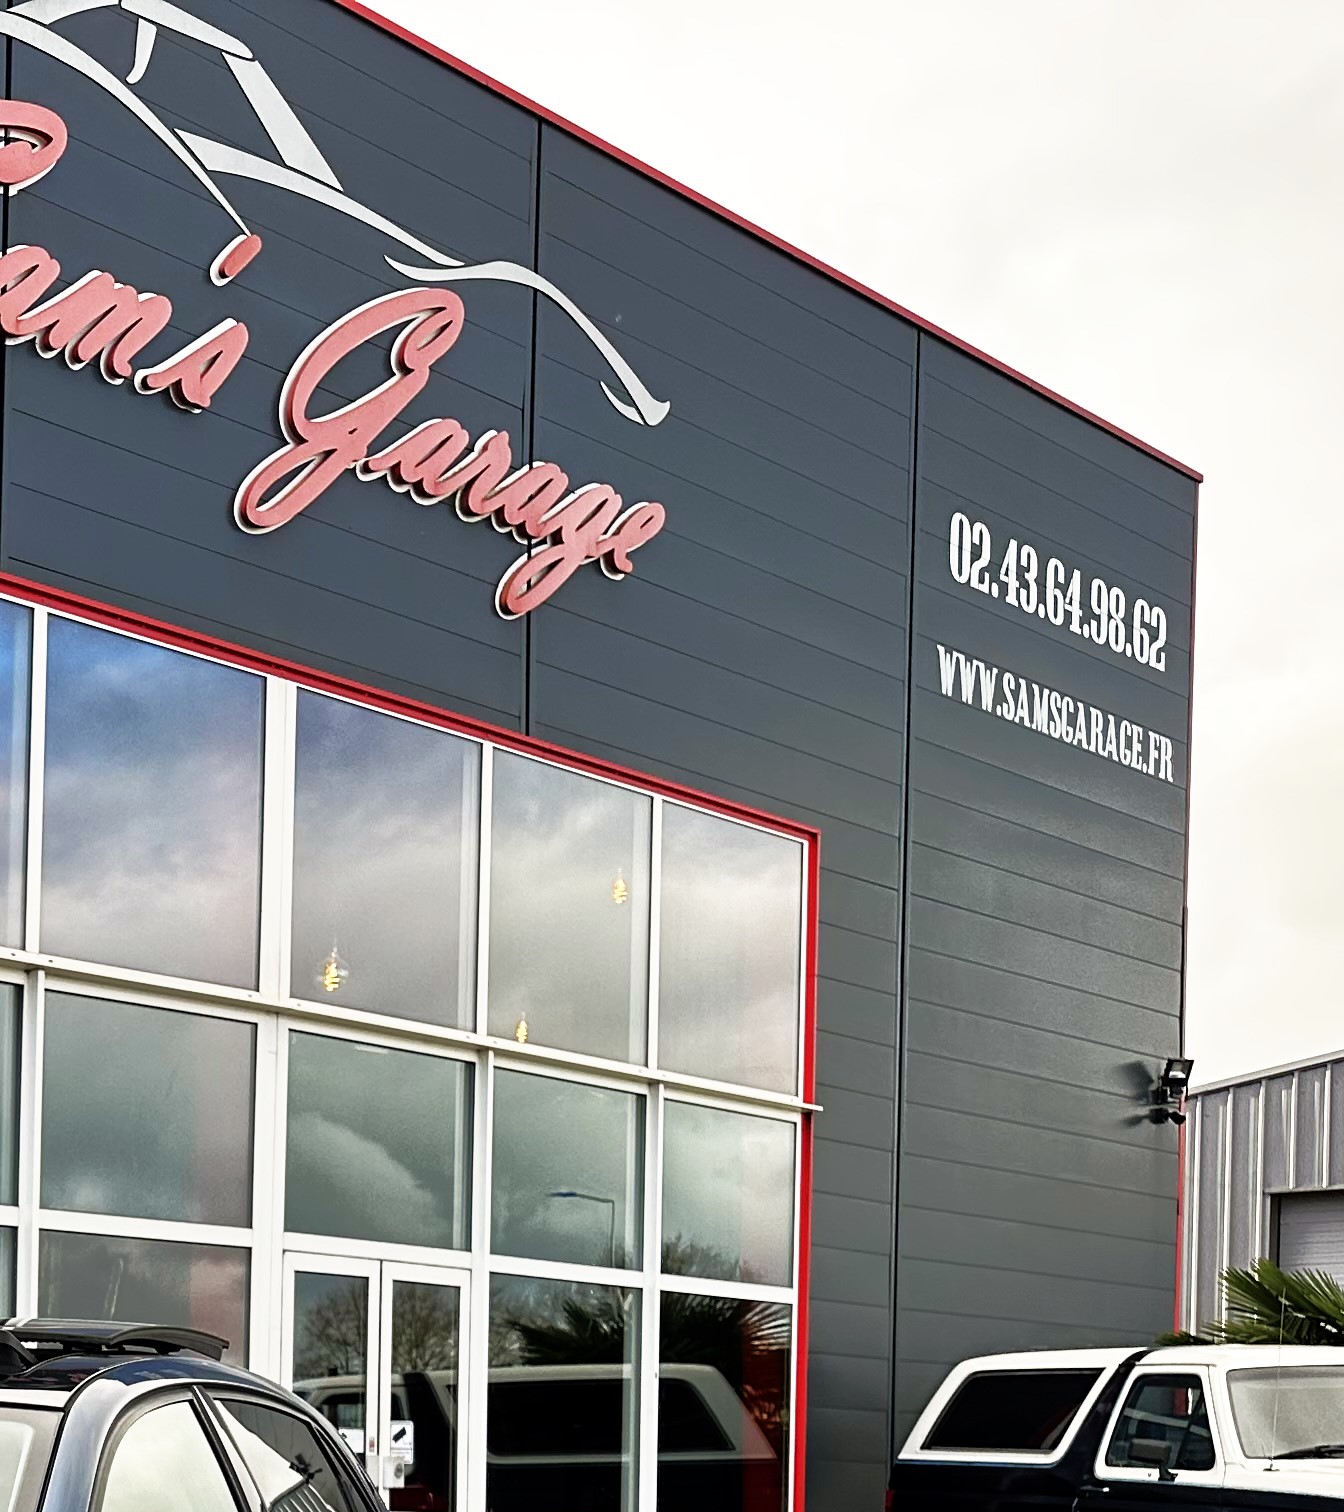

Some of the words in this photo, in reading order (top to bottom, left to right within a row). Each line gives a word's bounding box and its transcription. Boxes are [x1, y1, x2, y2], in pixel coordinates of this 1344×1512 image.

[234, 287, 666, 620] Garage
[948, 511, 1167, 673] 02.43.64.98.62
[936, 643, 1174, 783] WWW.SAMSGARAGE.FR
